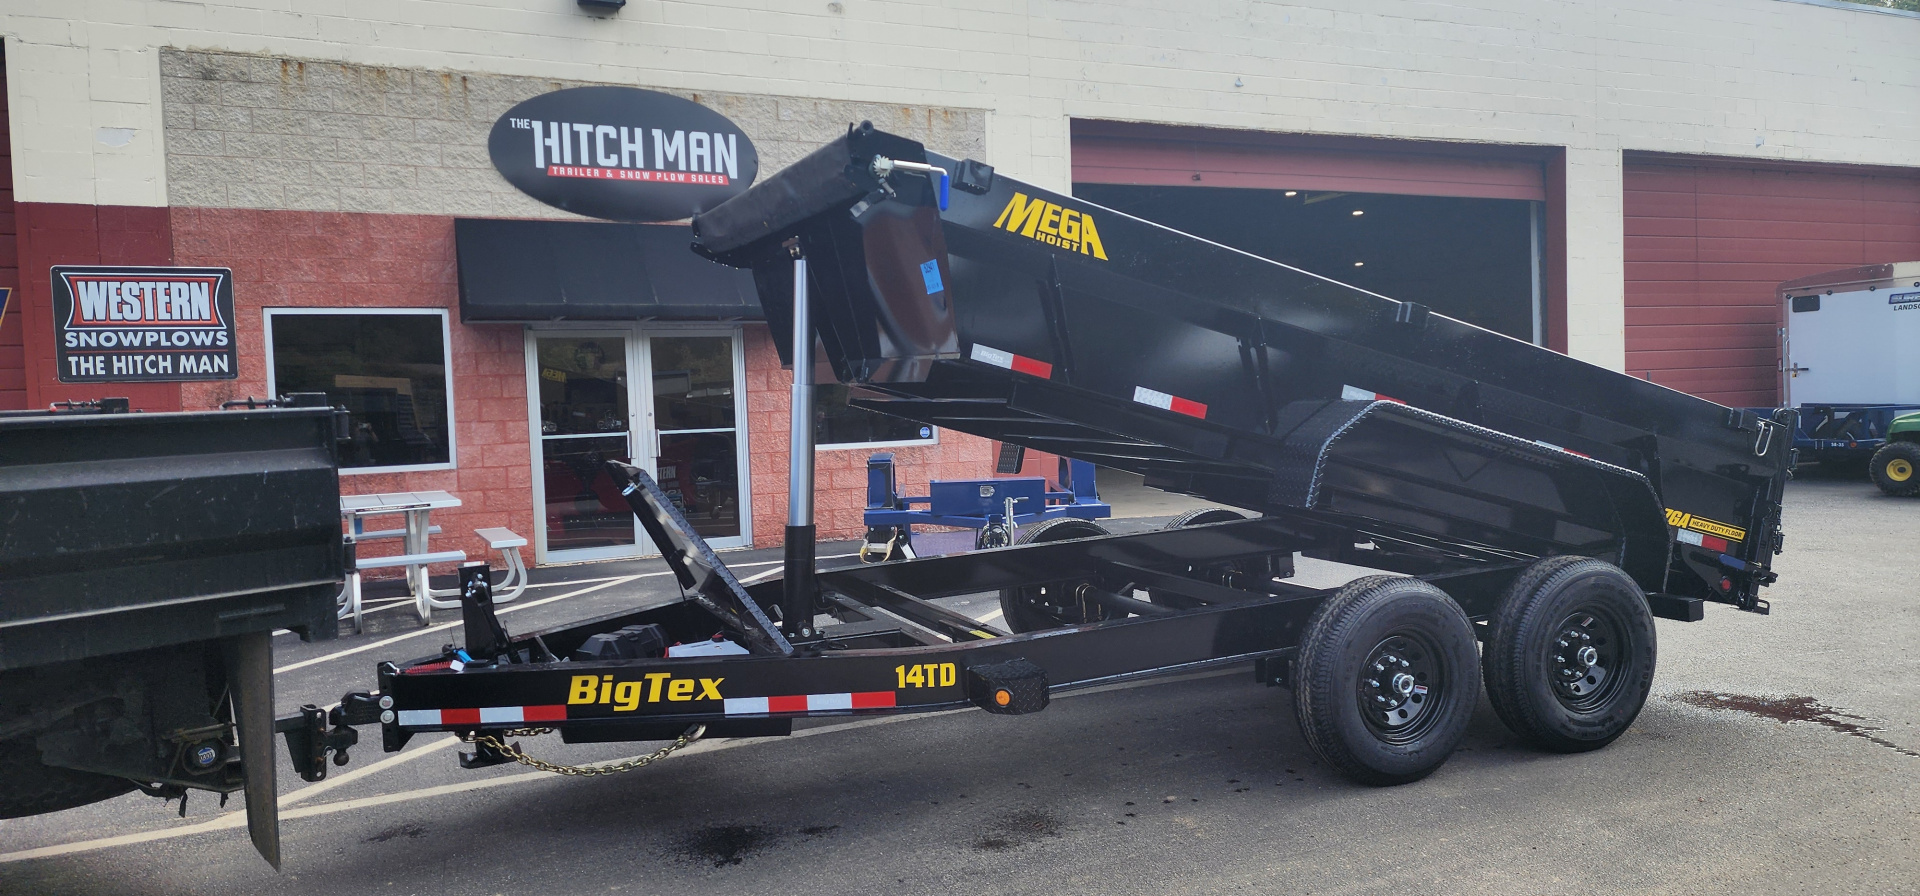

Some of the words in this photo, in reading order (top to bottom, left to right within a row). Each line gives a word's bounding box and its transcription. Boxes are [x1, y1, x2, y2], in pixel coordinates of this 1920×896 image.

[510, 117, 531, 130] THE
[531, 120, 644, 169] HITCH
[652, 128, 738, 179] MAN
[552, 166, 600, 177] TRAILER
[606, 169, 613, 178] &
[620, 170, 650, 180] SNOW
[656, 173, 685, 182] PLOW
[691, 174, 724, 184] SALES
[993, 191, 1109, 261] MEGA
[1035, 231, 1080, 252] HOIST
[76, 281, 212, 321] WESTERN
[64, 330, 229, 348] SNOWPLOWS
[67, 355, 106, 376] THE
[112, 354, 172, 375] HITCH
[179, 354, 229, 374] MAN
[1692, 520, 1711, 530] HEAVY
[1710, 525, 1725, 535] DUTY
[1724, 529, 1743, 539] FLOOR
[895, 662, 956, 688] 14TD
[567, 672, 725, 712] BigTex
